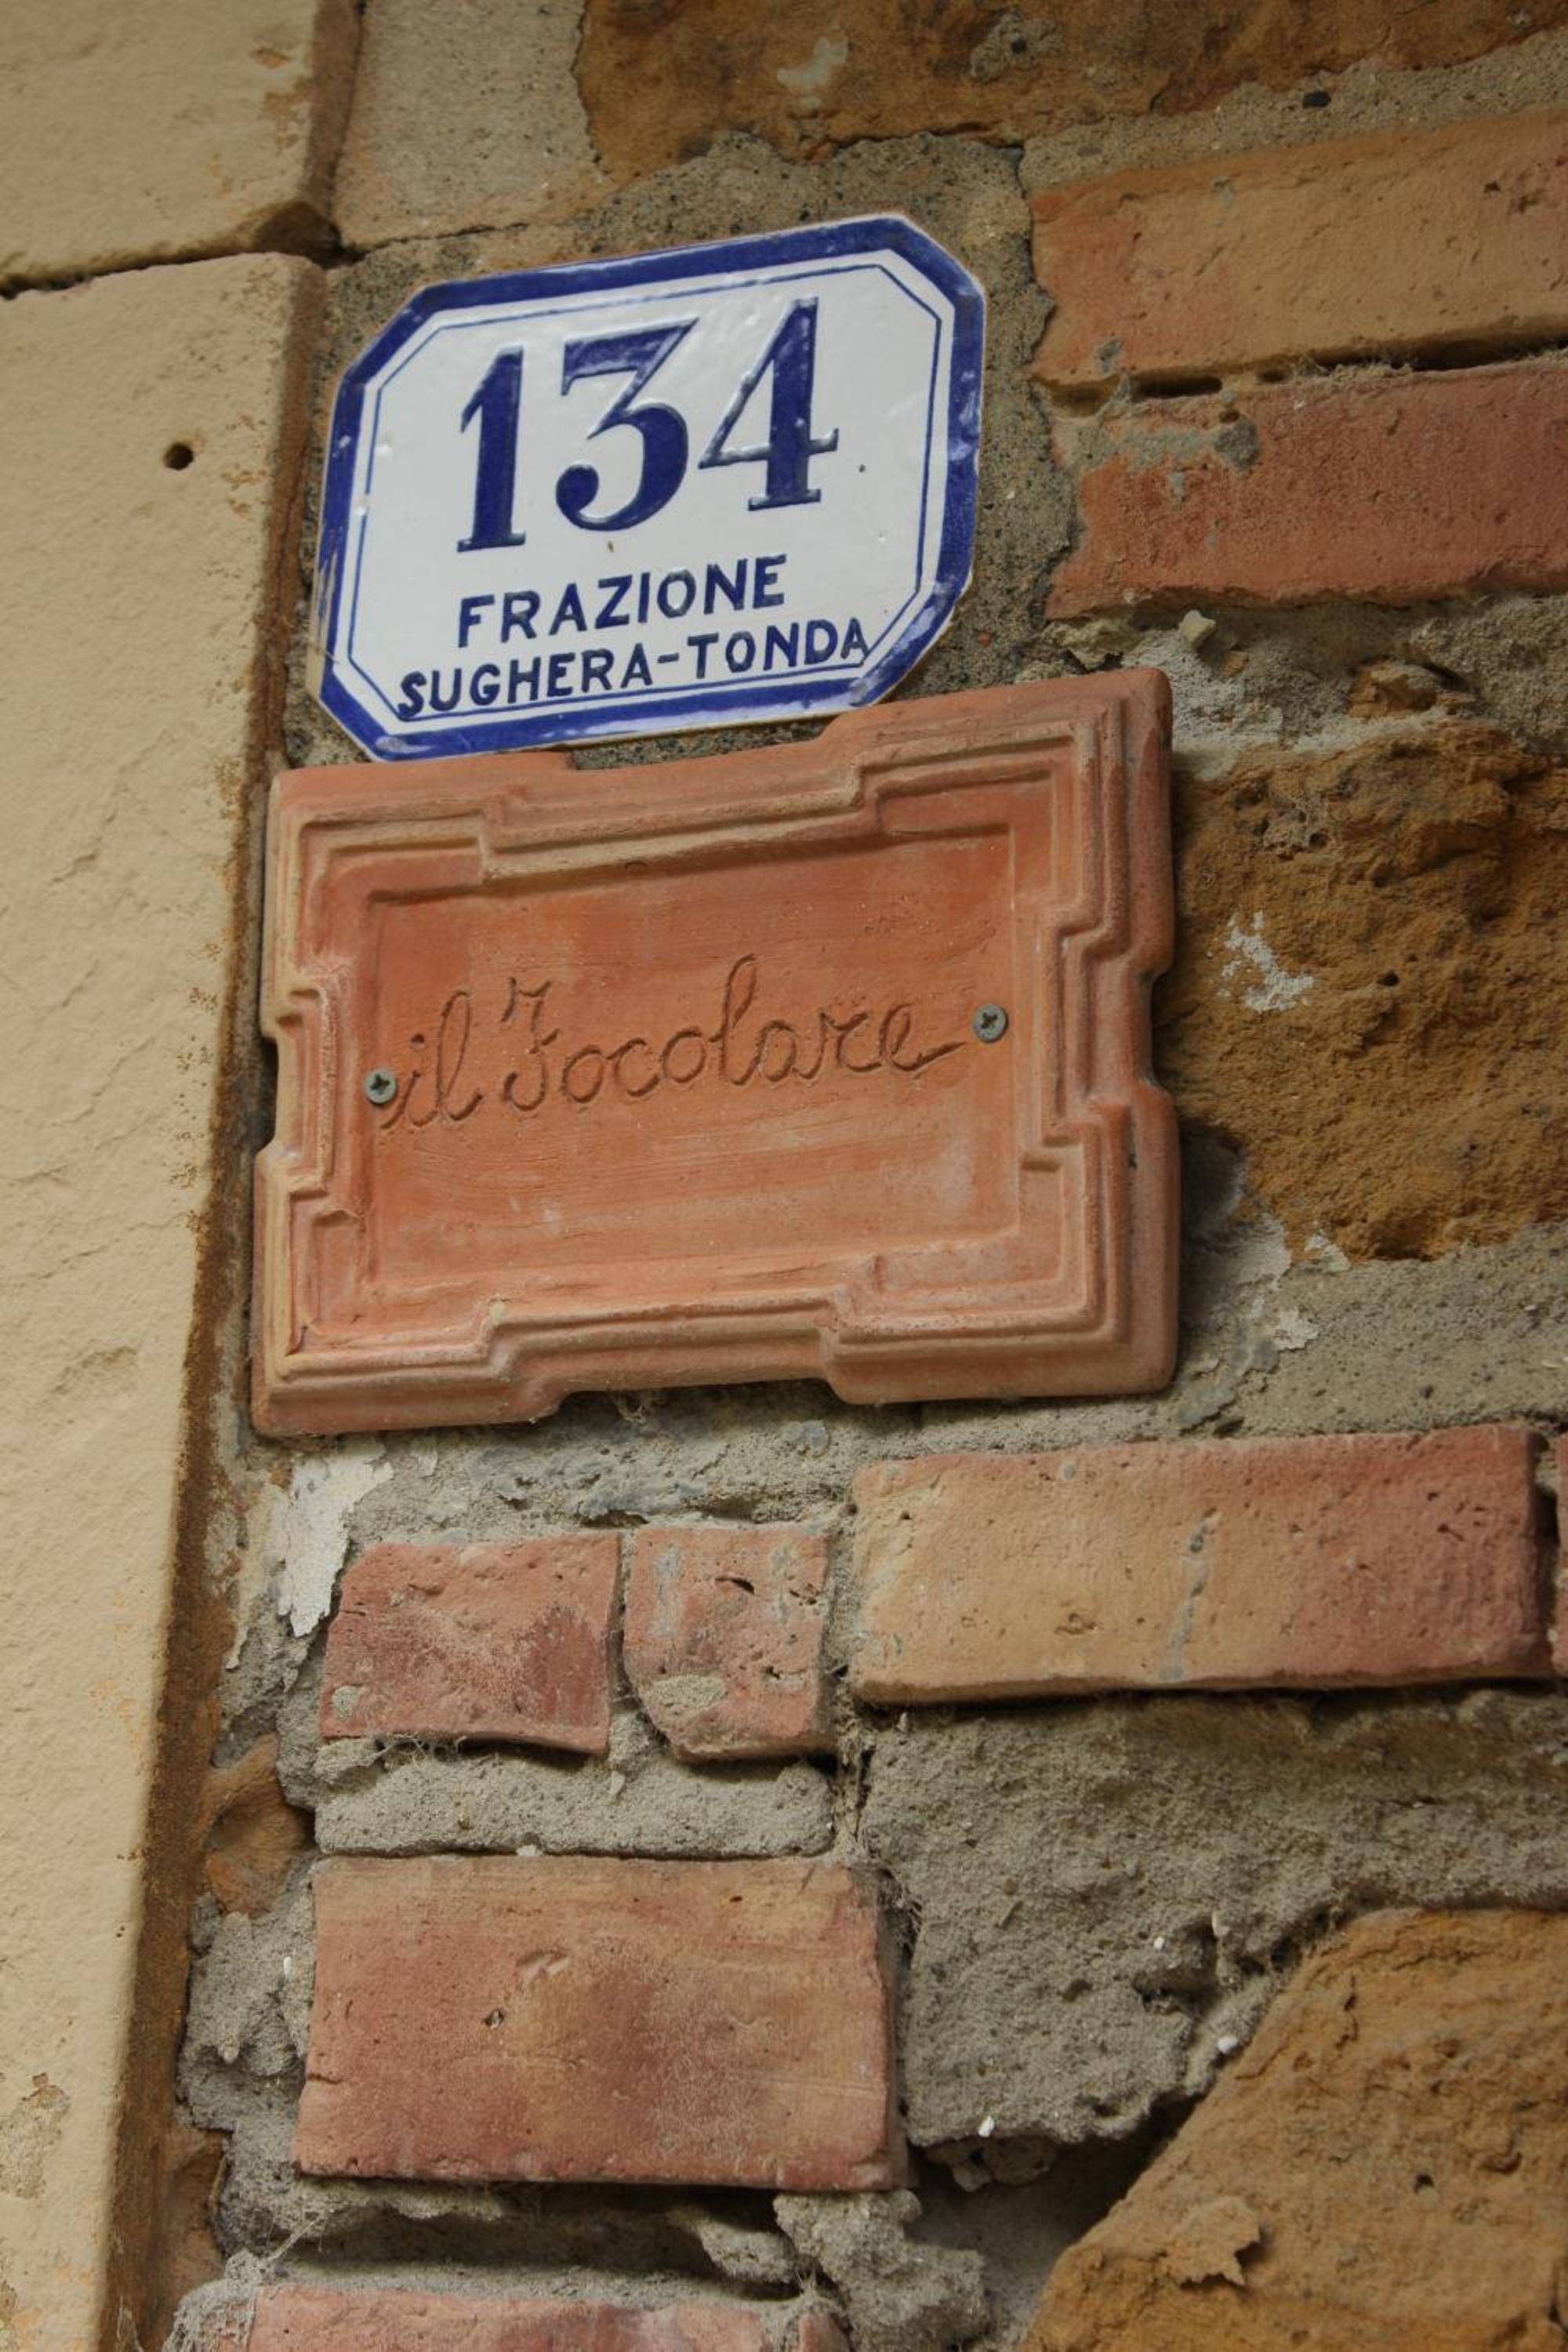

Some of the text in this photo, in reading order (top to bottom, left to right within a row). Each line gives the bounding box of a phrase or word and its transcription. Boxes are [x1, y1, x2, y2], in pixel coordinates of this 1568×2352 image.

[456, 296, 840, 552] 134
[397, 619, 870, 719] SUGHERA-TONDA
[457, 554, 787, 648] FRAZIONE
[380, 954, 967, 1130] il Focolare
